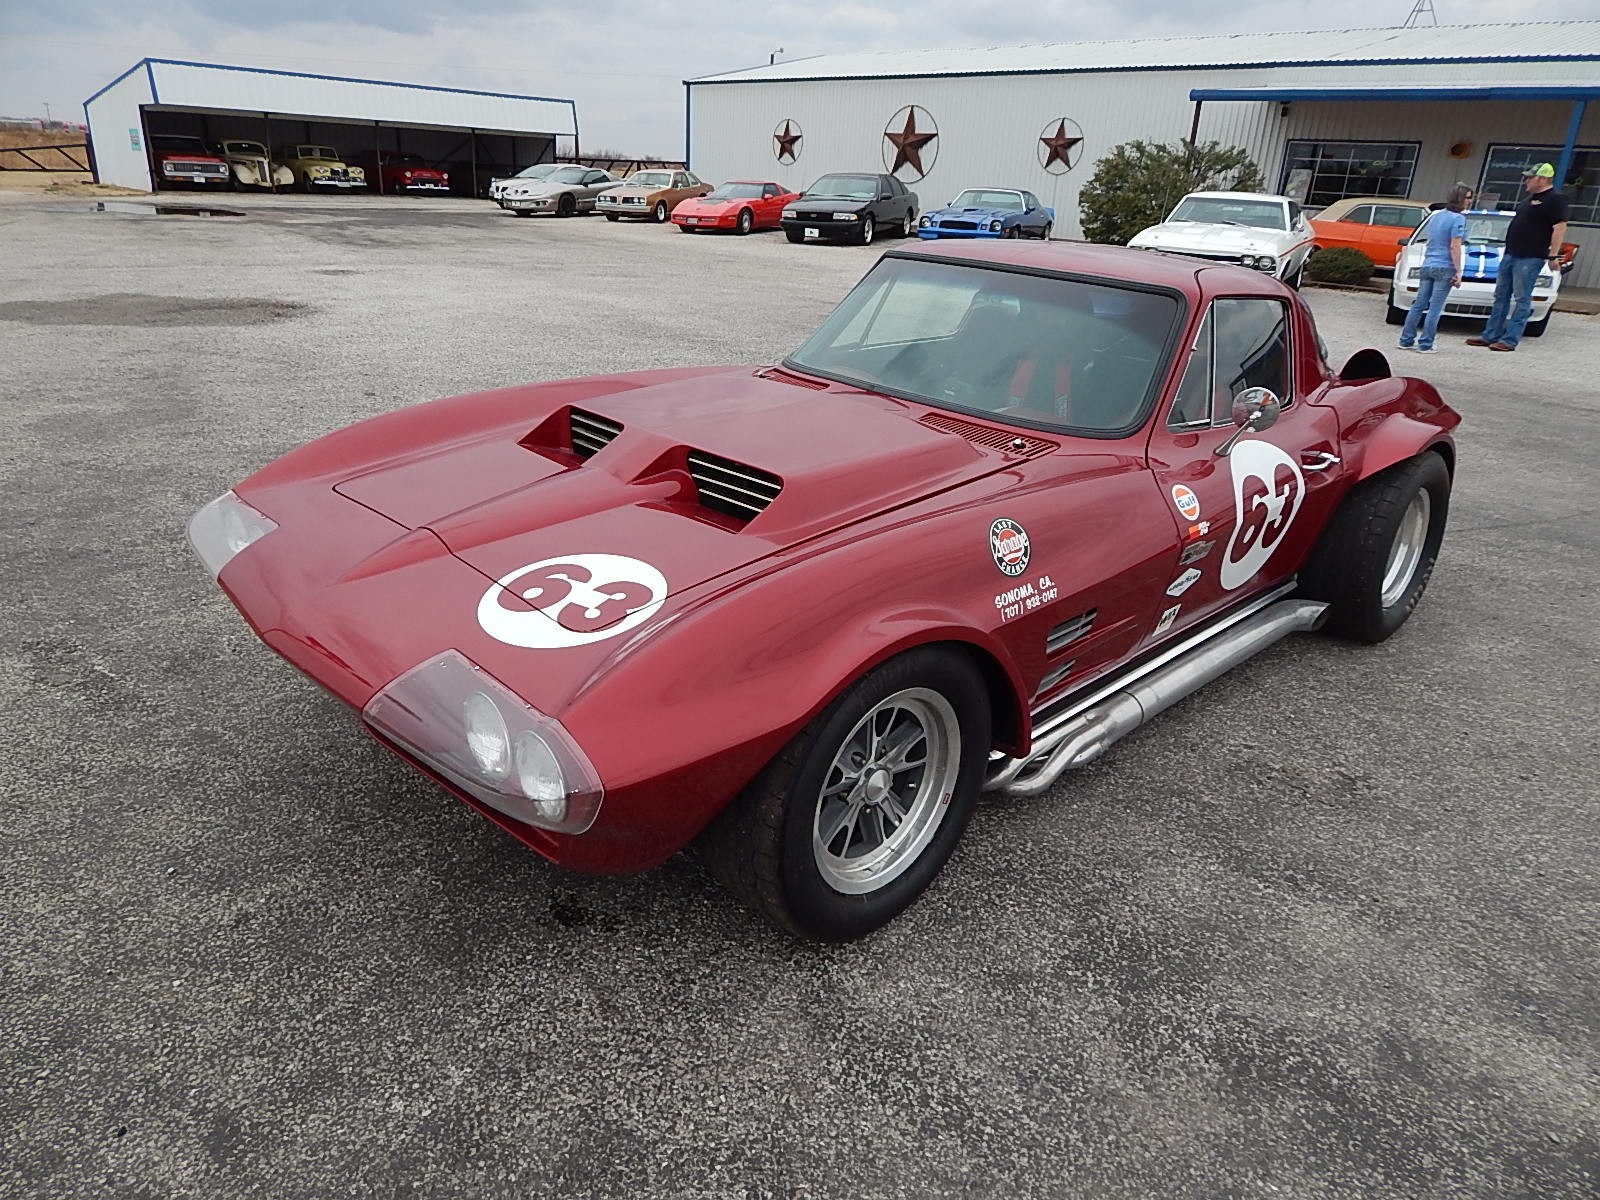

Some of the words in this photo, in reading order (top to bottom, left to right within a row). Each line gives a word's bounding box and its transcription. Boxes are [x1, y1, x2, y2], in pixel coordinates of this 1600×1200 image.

[1177, 495, 1196, 508] Gulf
[1230, 463, 1298, 564] 63
[993, 520, 1012, 534] LAST
[1001, 555, 1028, 574] CHANCE
[497, 563, 654, 634] 63
[994, 582, 1038, 609] SONOMA,
[1039, 575, 1056, 590] CA.
[1001, 600, 1024, 623] (707)
